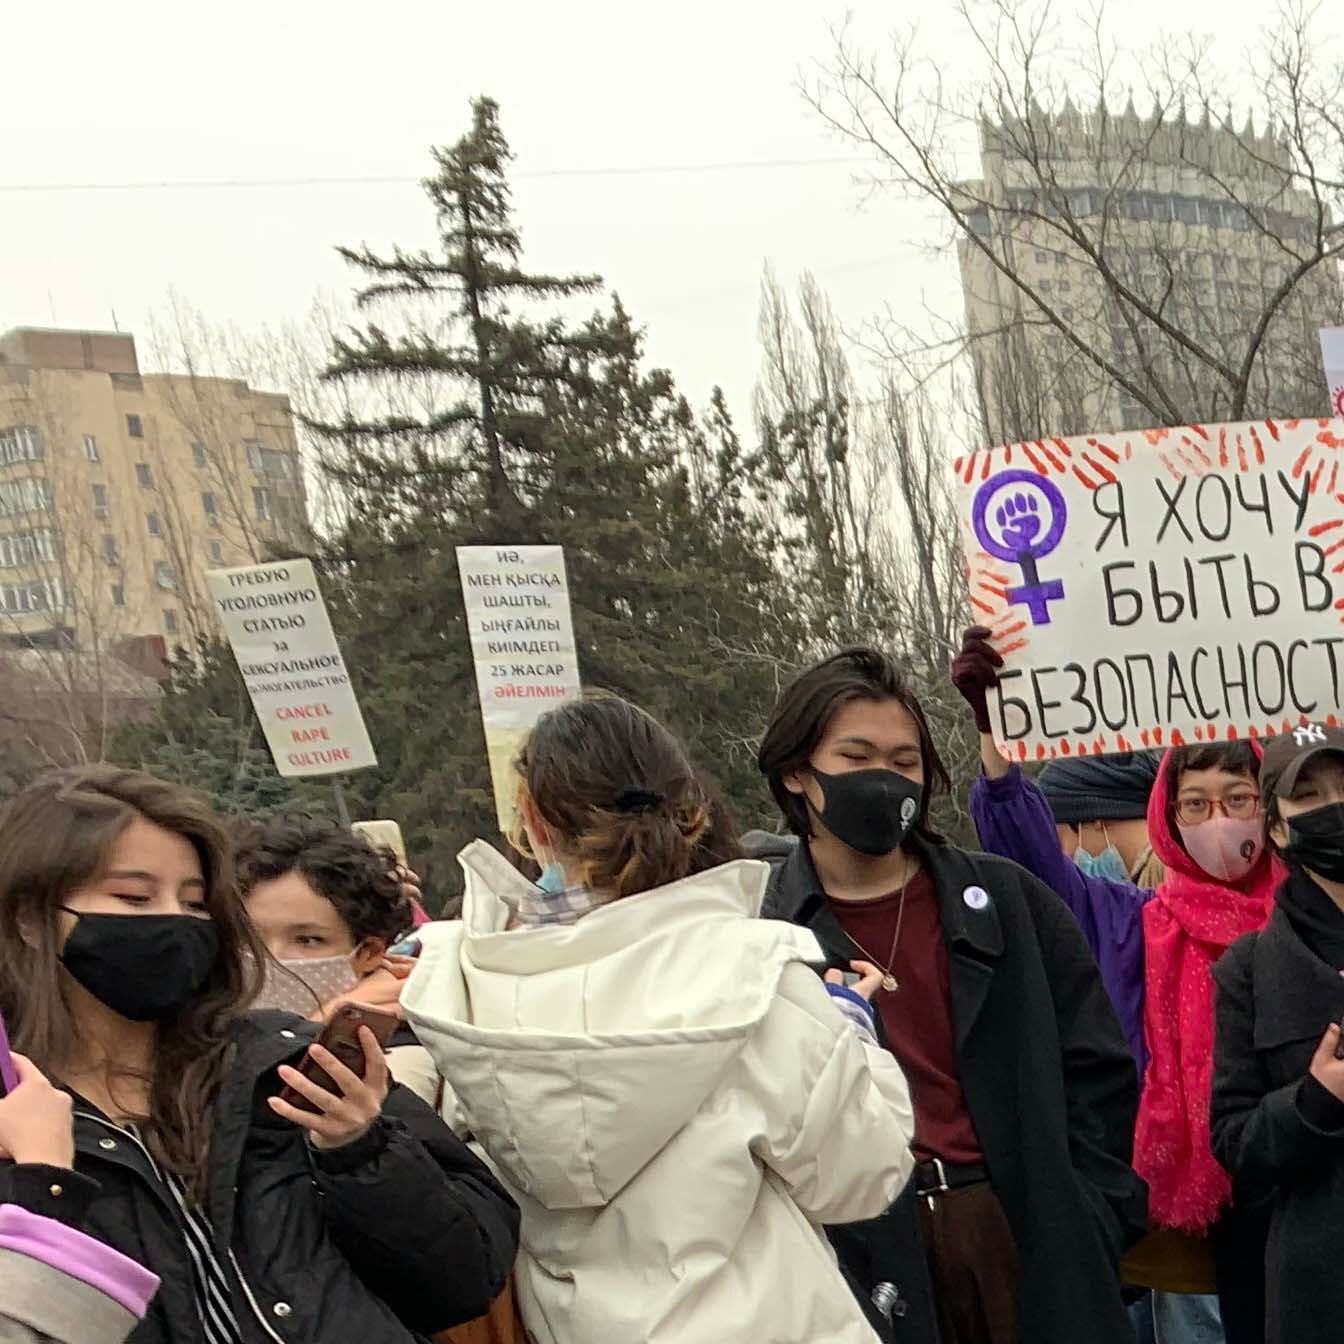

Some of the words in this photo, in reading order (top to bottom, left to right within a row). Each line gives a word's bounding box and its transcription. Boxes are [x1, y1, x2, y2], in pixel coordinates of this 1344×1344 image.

[1092, 480, 1129, 552] Я
[1155, 470, 1312, 544] ХОЧУ
[227, 568, 290, 587] ТРЕБУЮ
[467, 575, 502, 587] МЕН
[1101, 552, 1281, 627] БЫТЬ
[1295, 541, 1334, 613] В
[218, 589, 316, 611] УГОЛОВНУЮ
[243, 614, 305, 633] СТАТЬЮ
[242, 655, 340, 677] СЕКСУАЛЬНОЕ
[491, 664, 507, 677] 25
[511, 662, 565, 677] ЖАСАР
[275, 703, 333, 721] CANCEL
[292, 727, 331, 744] RAPE
[288, 748, 351, 767] CULTURE
